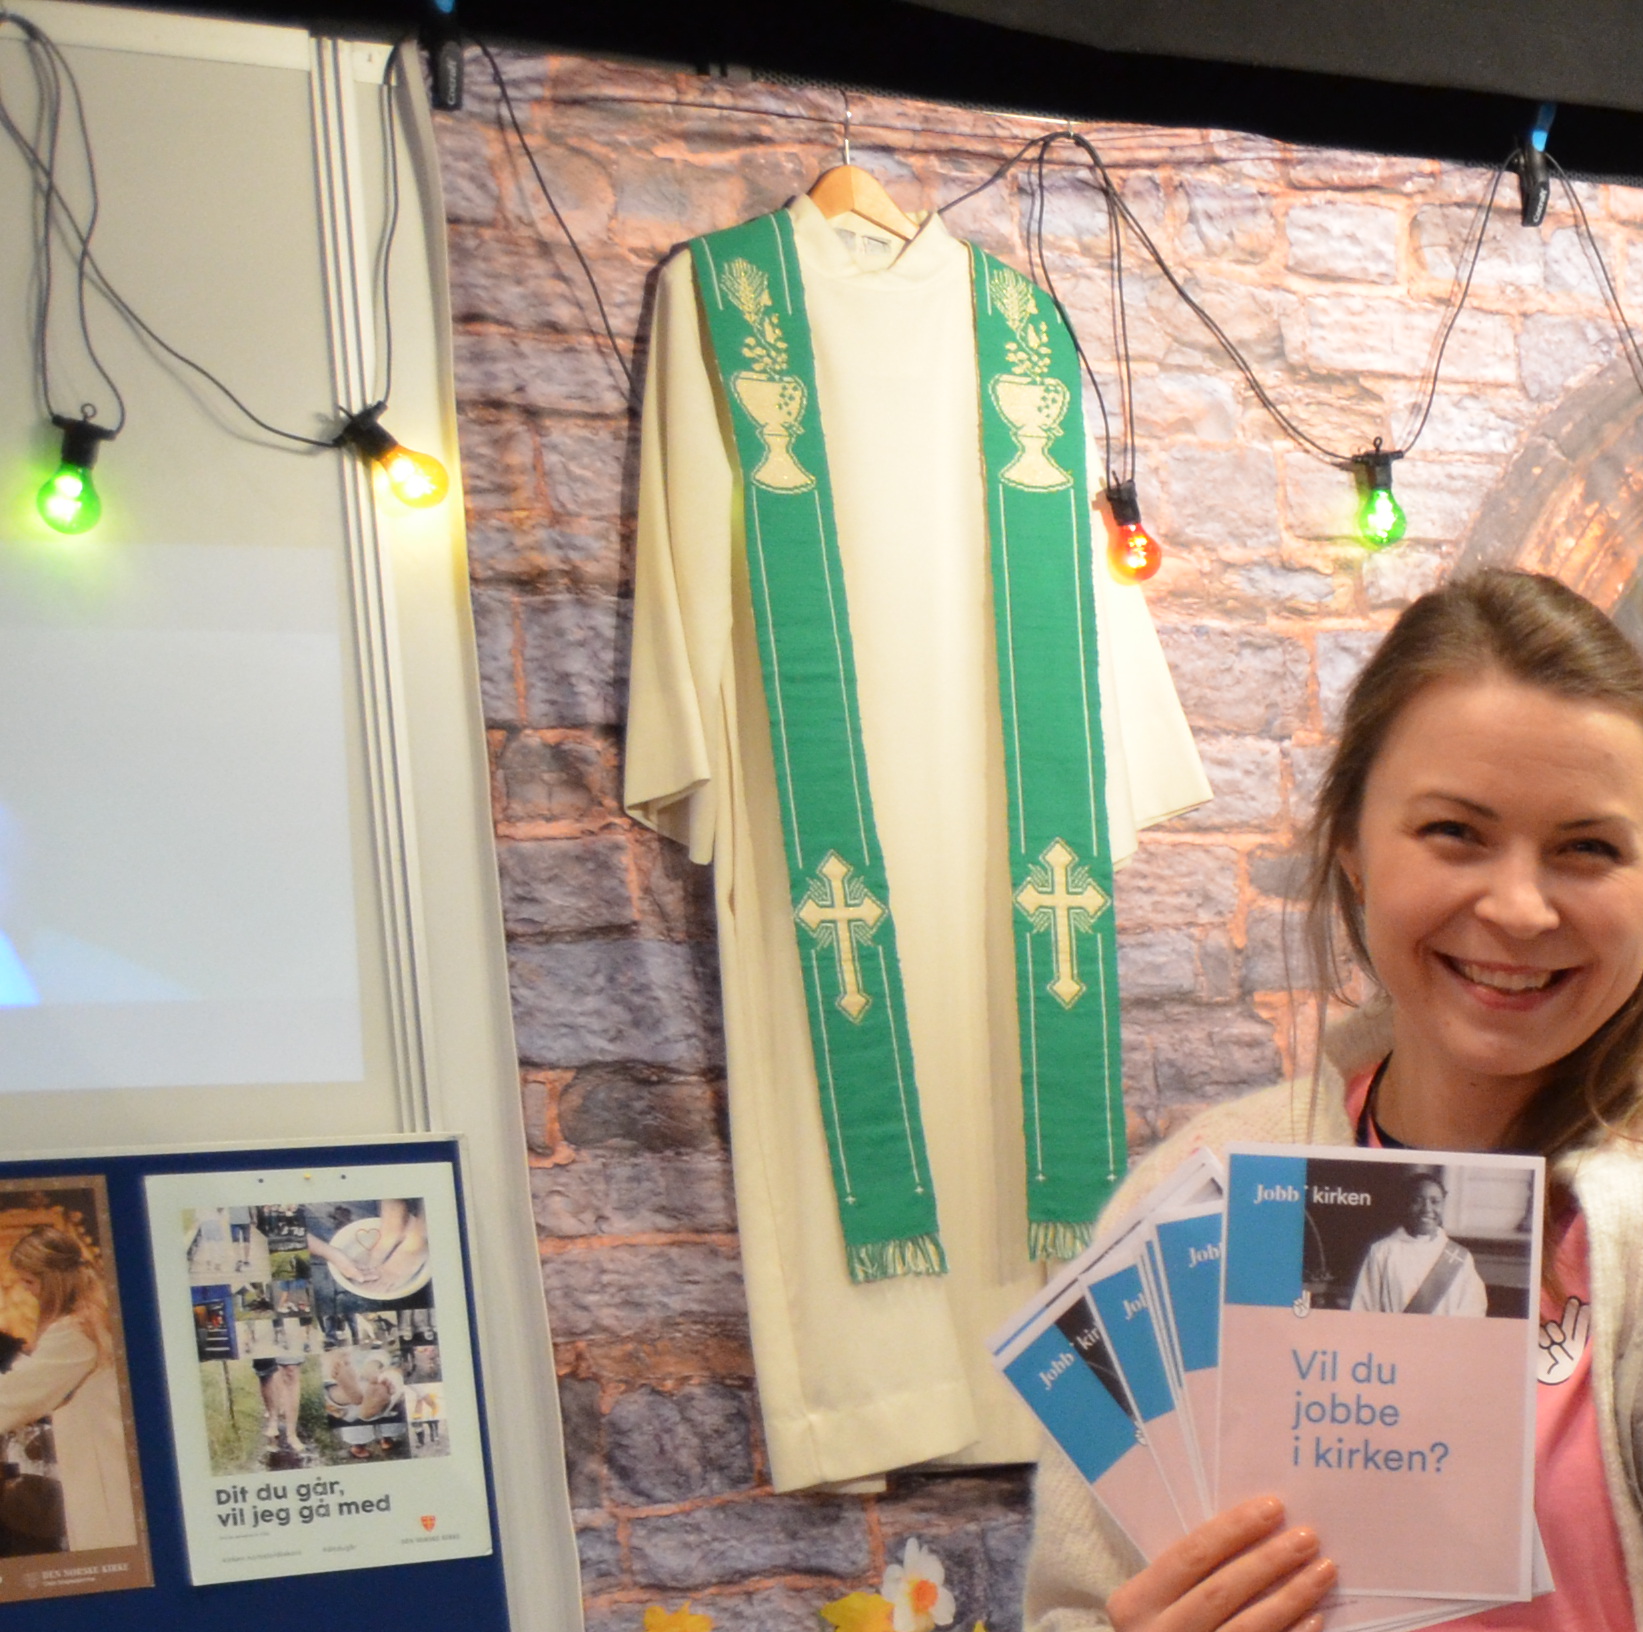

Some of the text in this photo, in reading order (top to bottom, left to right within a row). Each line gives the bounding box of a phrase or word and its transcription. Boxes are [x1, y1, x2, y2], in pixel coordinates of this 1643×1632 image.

[1254, 1184, 1371, 1206] Jobb kirken
[1123, 1292, 1149, 1320] Jo
[1039, 1326, 1101, 1390] Jobb kir
[1291, 1349, 1396, 1384] Vil du
[1291, 1394, 1400, 1430] jobbe
[1293, 1437, 1449, 1474] i kirken?
[216, 1477, 345, 1505] Dit du går,
[217, 1494, 391, 1528] vil jeg gå med
